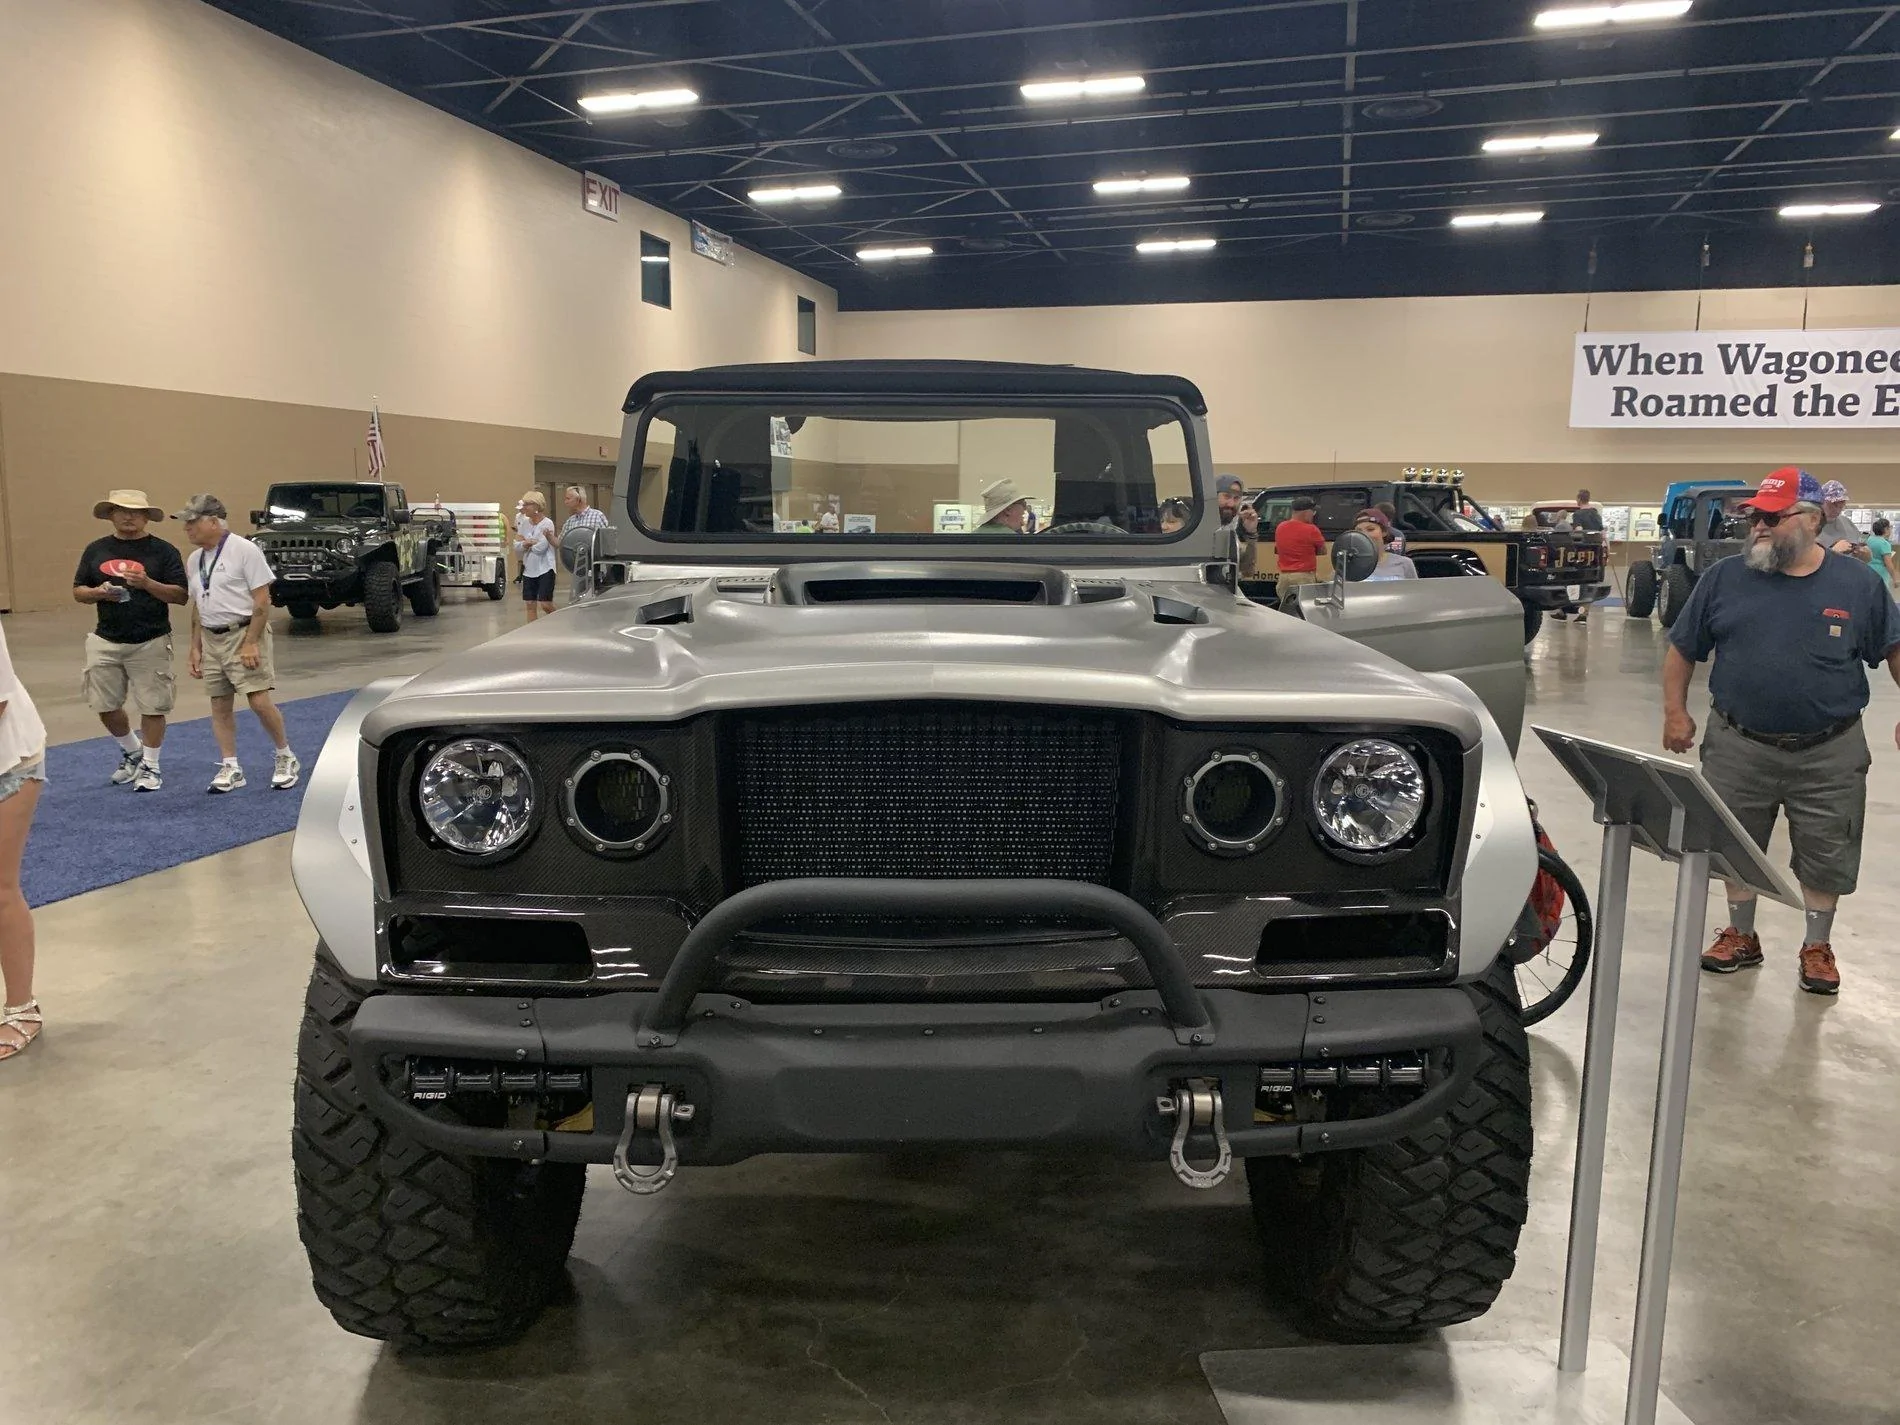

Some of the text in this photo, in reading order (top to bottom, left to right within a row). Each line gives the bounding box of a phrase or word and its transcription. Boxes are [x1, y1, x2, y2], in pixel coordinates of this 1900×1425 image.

[586, 177, 620, 214] EXIT
[1582, 342, 1703, 376] When
[1610, 383, 1778, 418] Roamed
[1792, 383, 1860, 418] the
[1554, 546, 1595, 568] Jeep
[413, 1092, 447, 1100] RIGID
